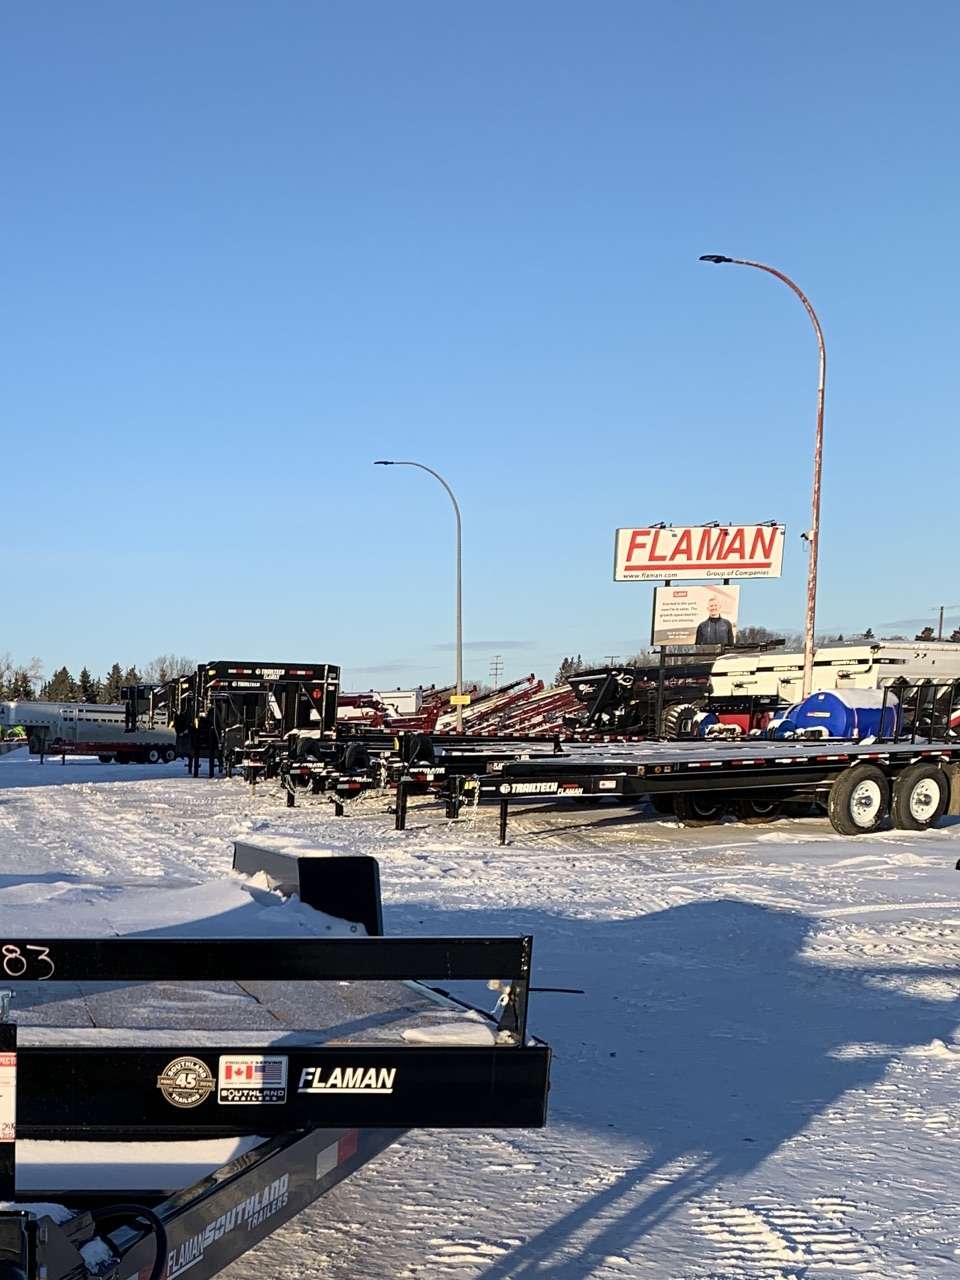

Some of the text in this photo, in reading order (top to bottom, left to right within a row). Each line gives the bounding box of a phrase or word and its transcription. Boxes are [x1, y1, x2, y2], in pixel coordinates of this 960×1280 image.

[625, 528, 778, 562] FLAMAN
[511, 782, 558, 794] TRAILTECH
[167, 1060, 207, 1078] SOUTHLAND
[298, 1067, 396, 1088] FLAMAN
[175, 1072, 197, 1089] 45
[171, 1094, 200, 1104] TRAILERS
[221, 1089, 285, 1097] SOUTHLAND
[204, 1173, 289, 1248] SOUTHLAND
[248, 1192, 289, 1231] TRAILERS
[166, 1231, 205, 1277] FLAMAN
